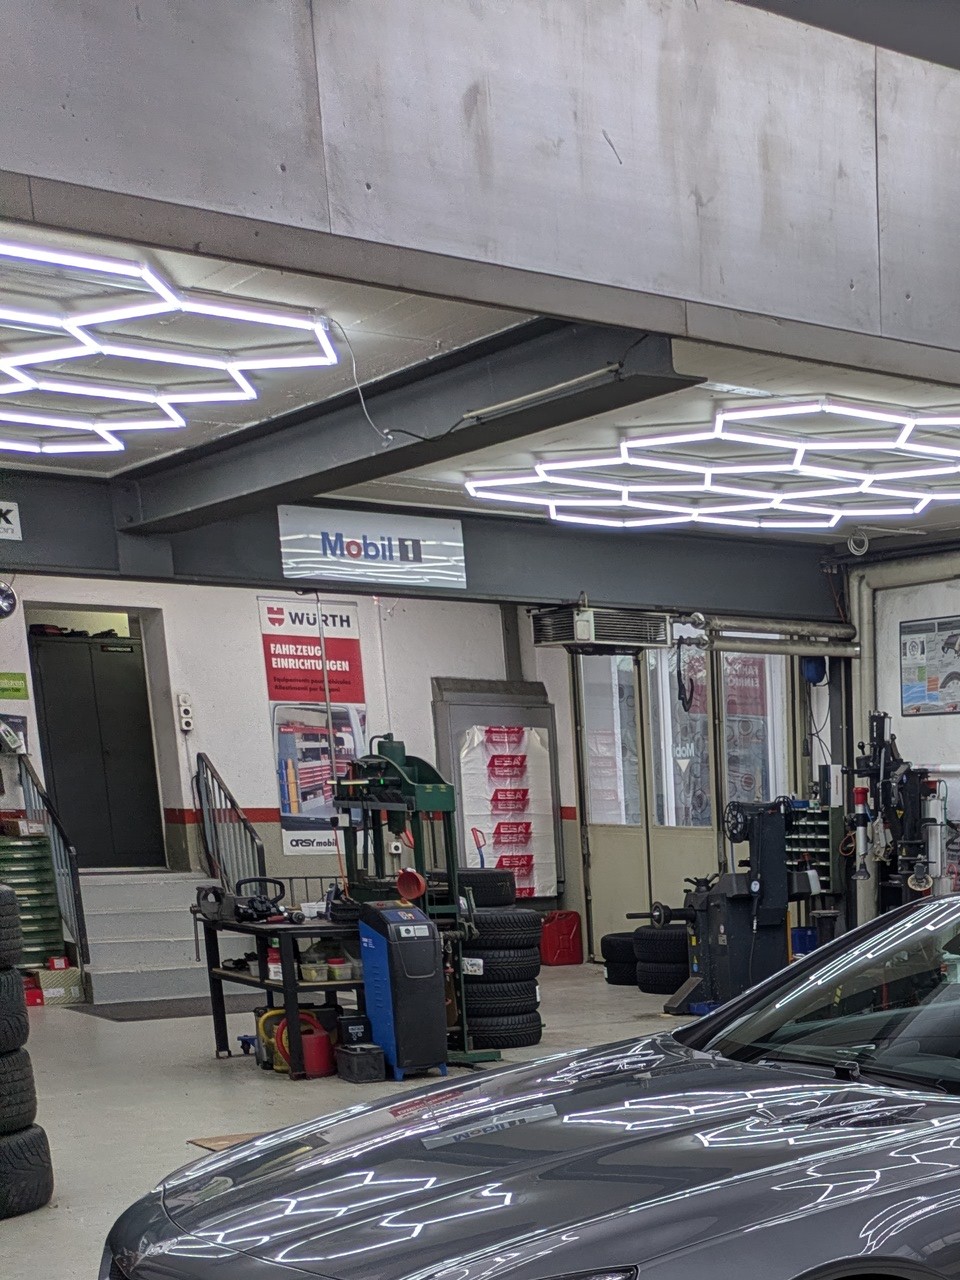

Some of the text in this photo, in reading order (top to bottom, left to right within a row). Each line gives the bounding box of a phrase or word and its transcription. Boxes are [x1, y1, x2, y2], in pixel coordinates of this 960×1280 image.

[320, 531, 394, 561] Mobil
[288, 611, 351, 628] WÜRTH
[270, 643, 322, 656] FAHRZEUG
